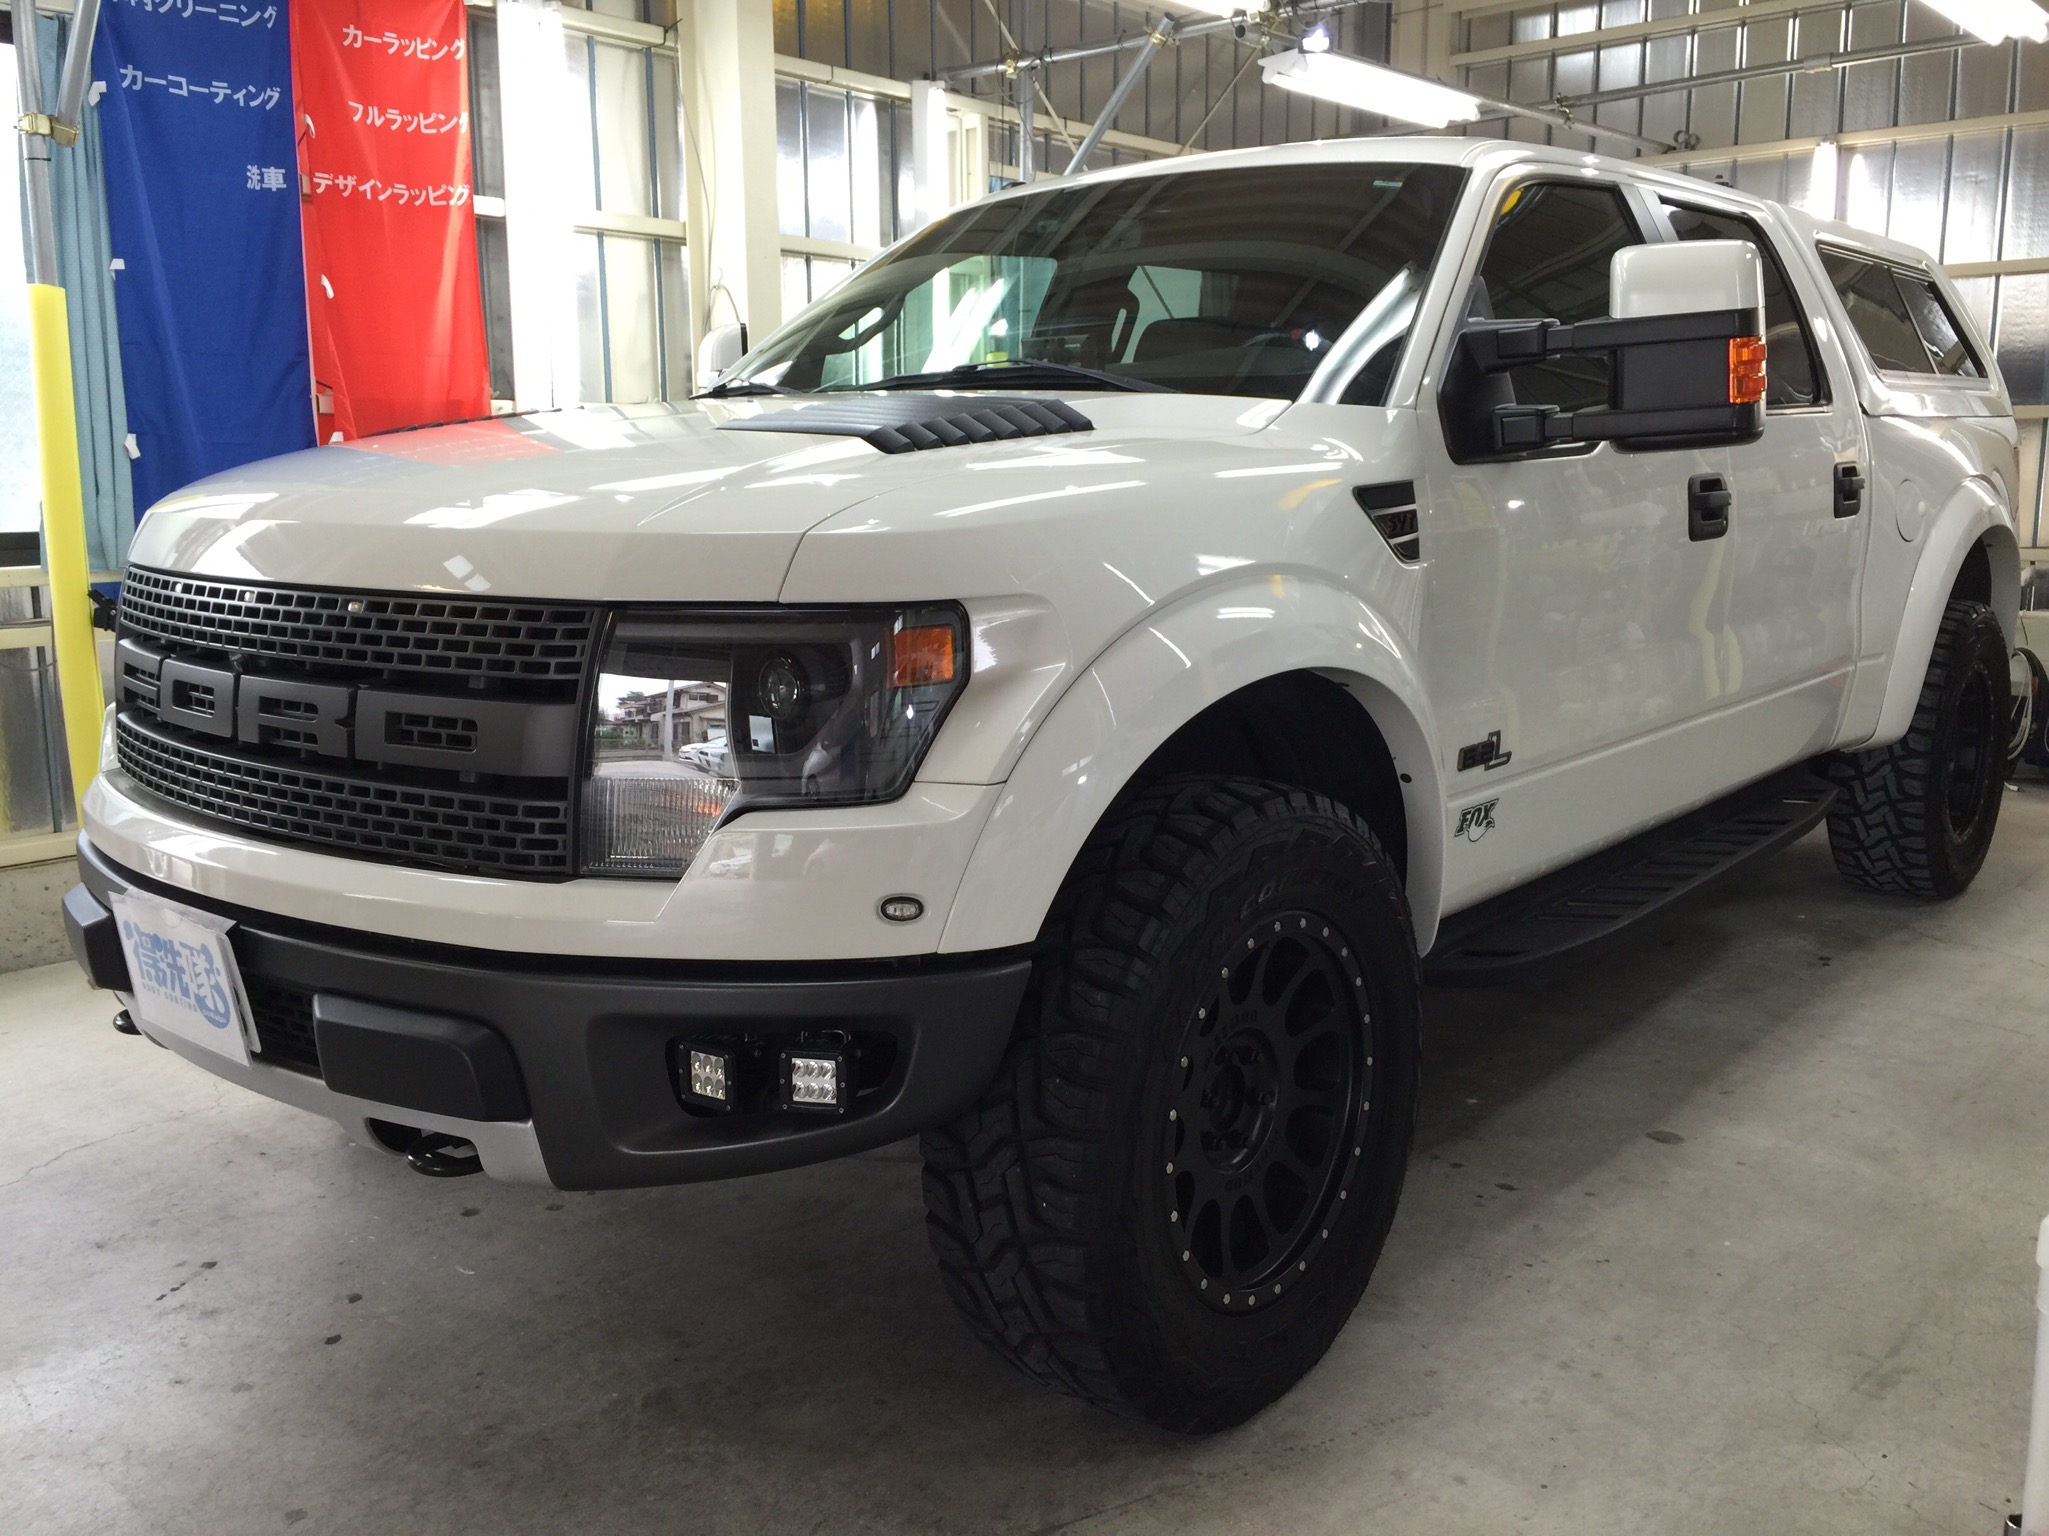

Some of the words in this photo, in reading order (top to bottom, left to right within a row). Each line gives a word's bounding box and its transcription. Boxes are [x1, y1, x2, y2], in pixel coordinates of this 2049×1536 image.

[342, 24, 465, 61] カーラッピング
[119, 64, 281, 110] カーコーティング
[348, 100, 468, 134] フルラッピング
[246, 164, 287, 192] 洗車
[313, 172, 470, 206] デザインラッピング
[117, 637, 574, 778] FORD
[1455, 798, 1499, 837] FOX
